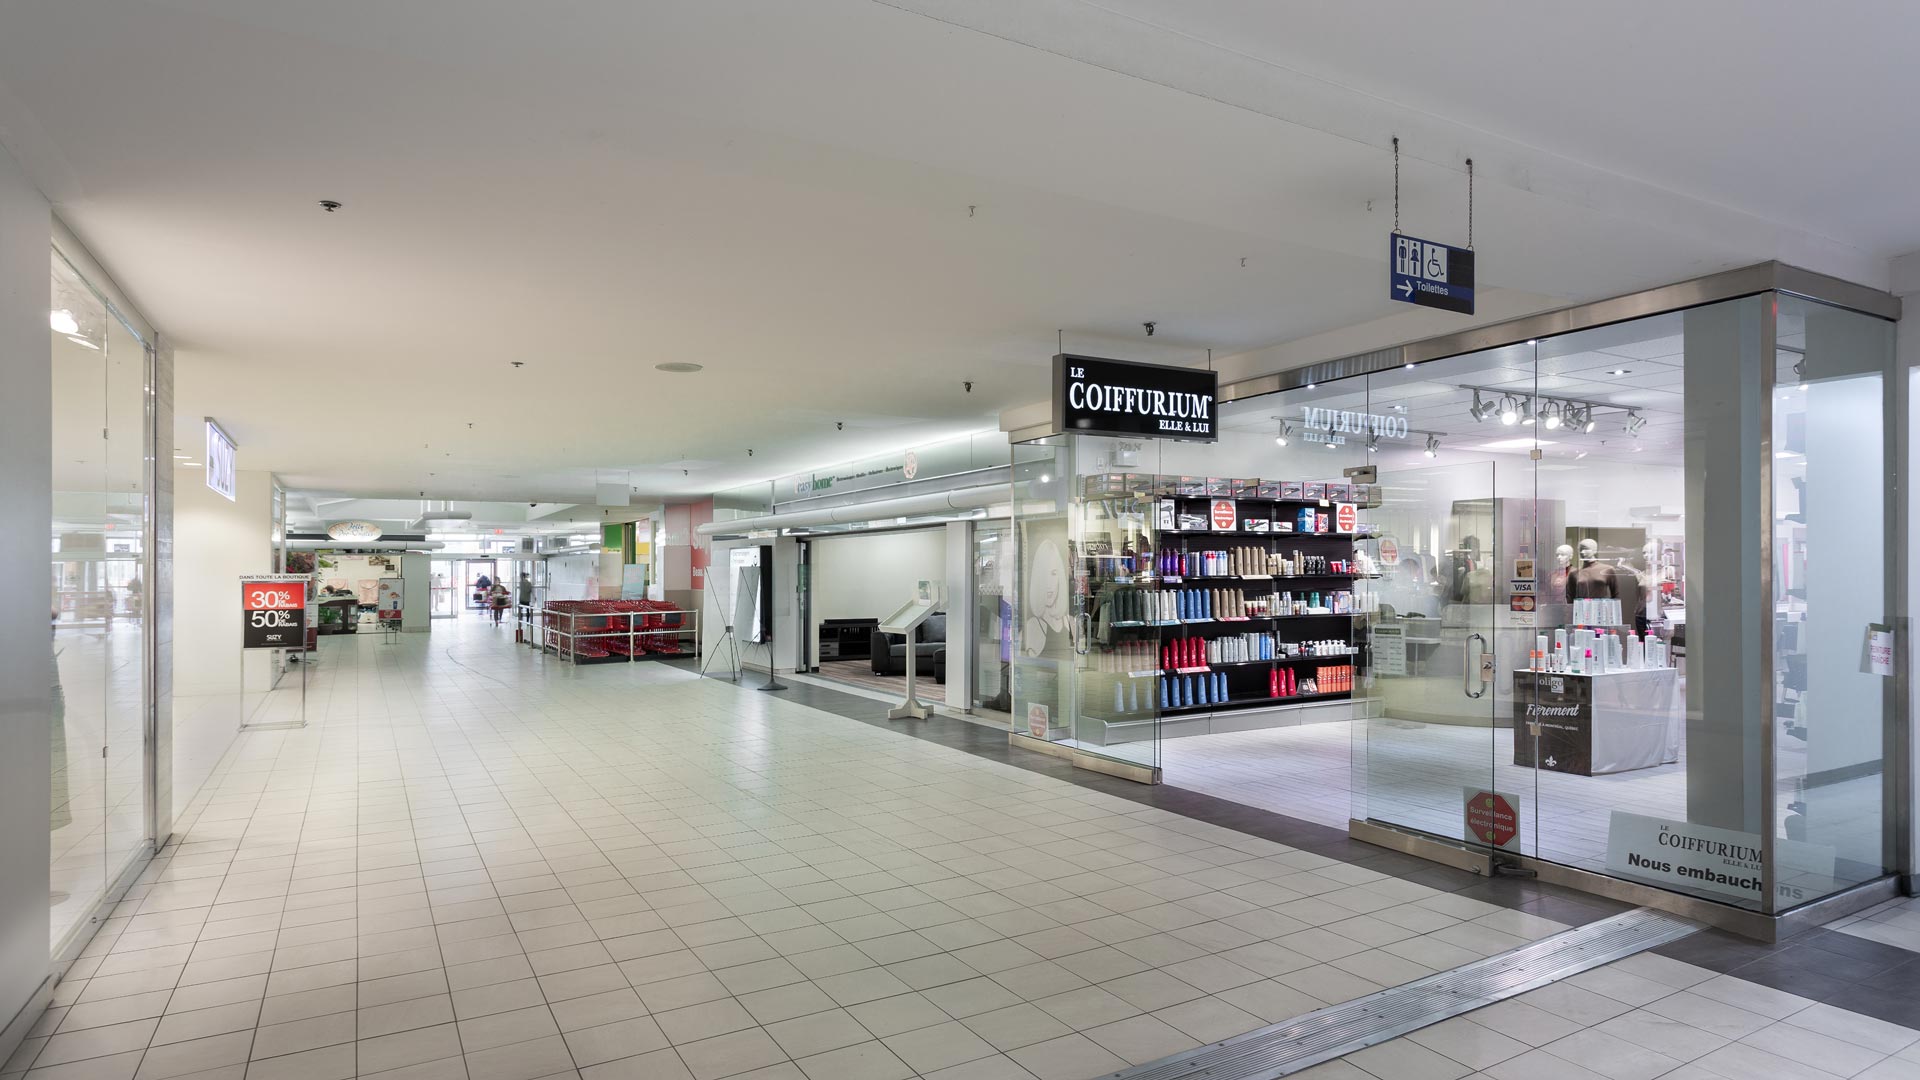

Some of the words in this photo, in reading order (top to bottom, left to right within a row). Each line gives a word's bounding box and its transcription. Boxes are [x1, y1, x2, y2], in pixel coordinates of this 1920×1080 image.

[1416, 281, 1448, 295] Toilettes
[1070, 367, 1085, 379] LE
[1159, 420, 1183, 431] ELLE
[1184, 422, 1191, 432] &
[1193, 423, 1210, 433] LUI
[251, 590, 290, 608] 30%
[251, 610, 290, 628] 50%
[1539, 677, 1562, 690] oligo
[1628, 852, 1671, 872] Nous
[1723, 858, 1743, 867] ELLE
